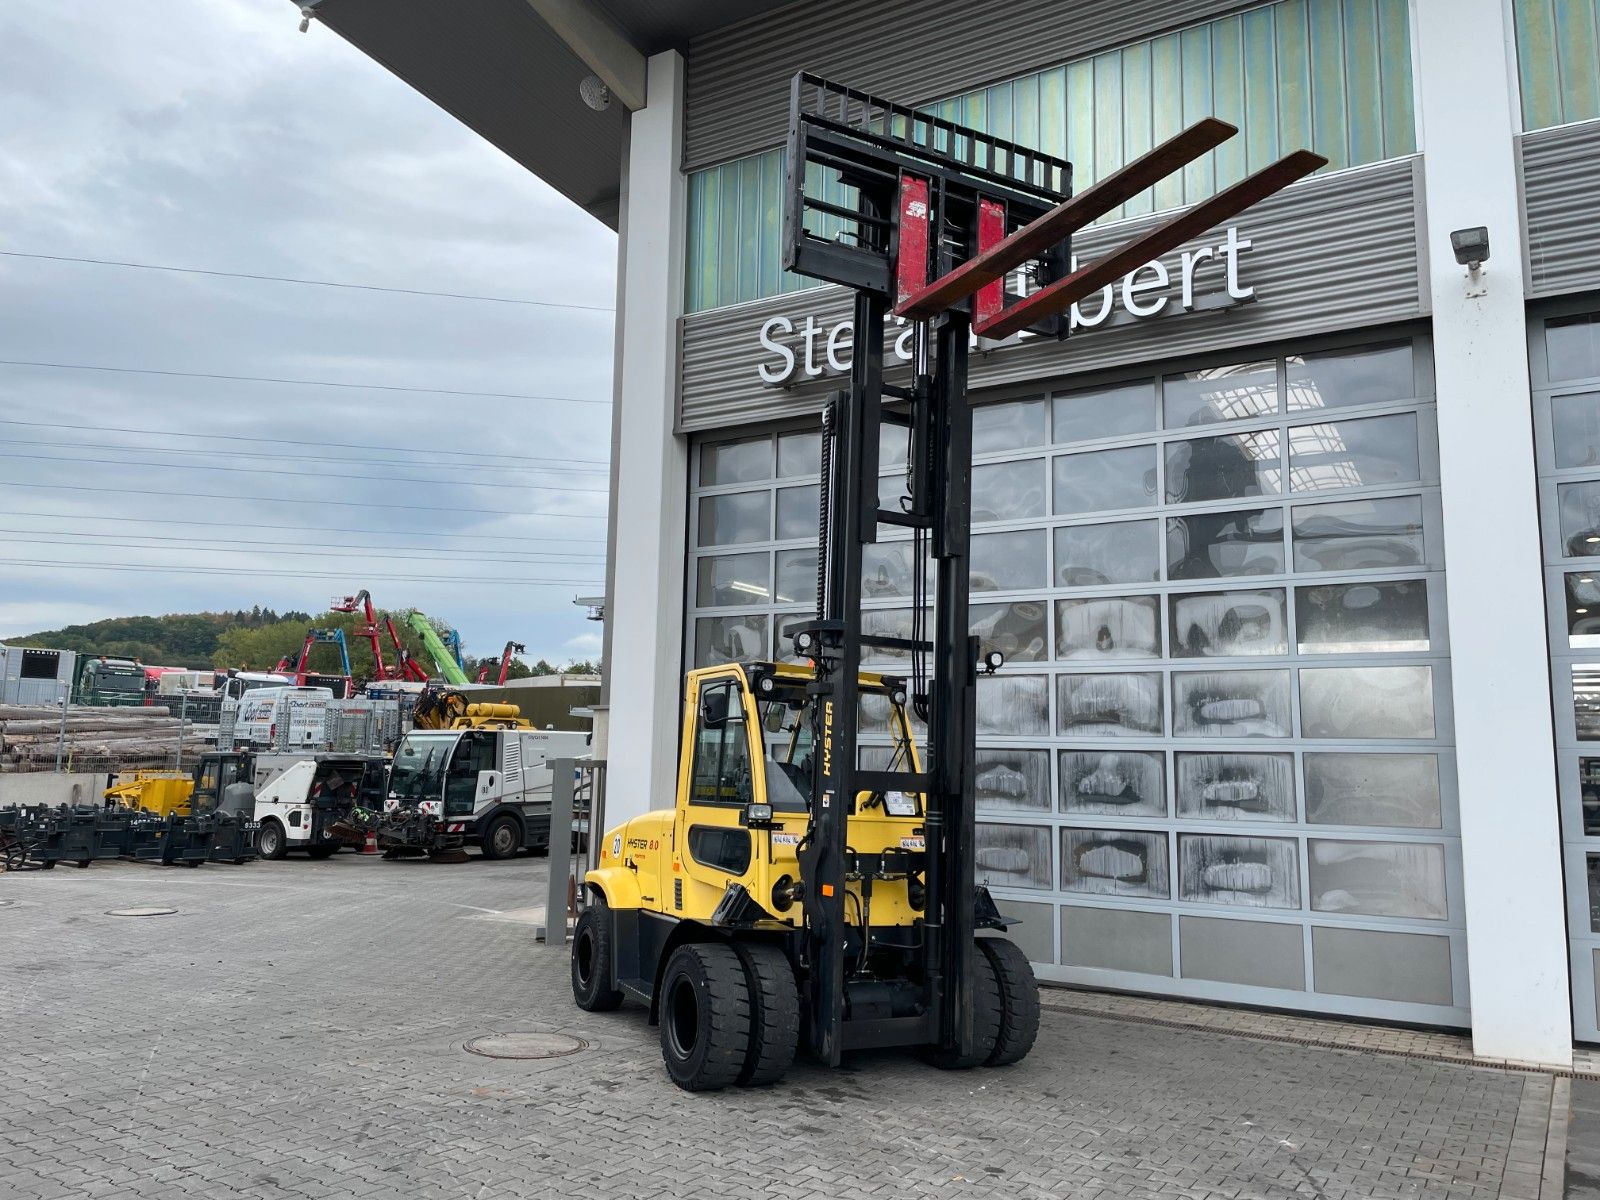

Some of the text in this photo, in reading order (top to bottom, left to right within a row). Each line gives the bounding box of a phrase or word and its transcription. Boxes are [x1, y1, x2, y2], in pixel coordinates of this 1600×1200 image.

[823, 700, 834, 777] HYSTER
[613, 838, 621, 854] 20
[627, 838, 648, 850] HYSTER
